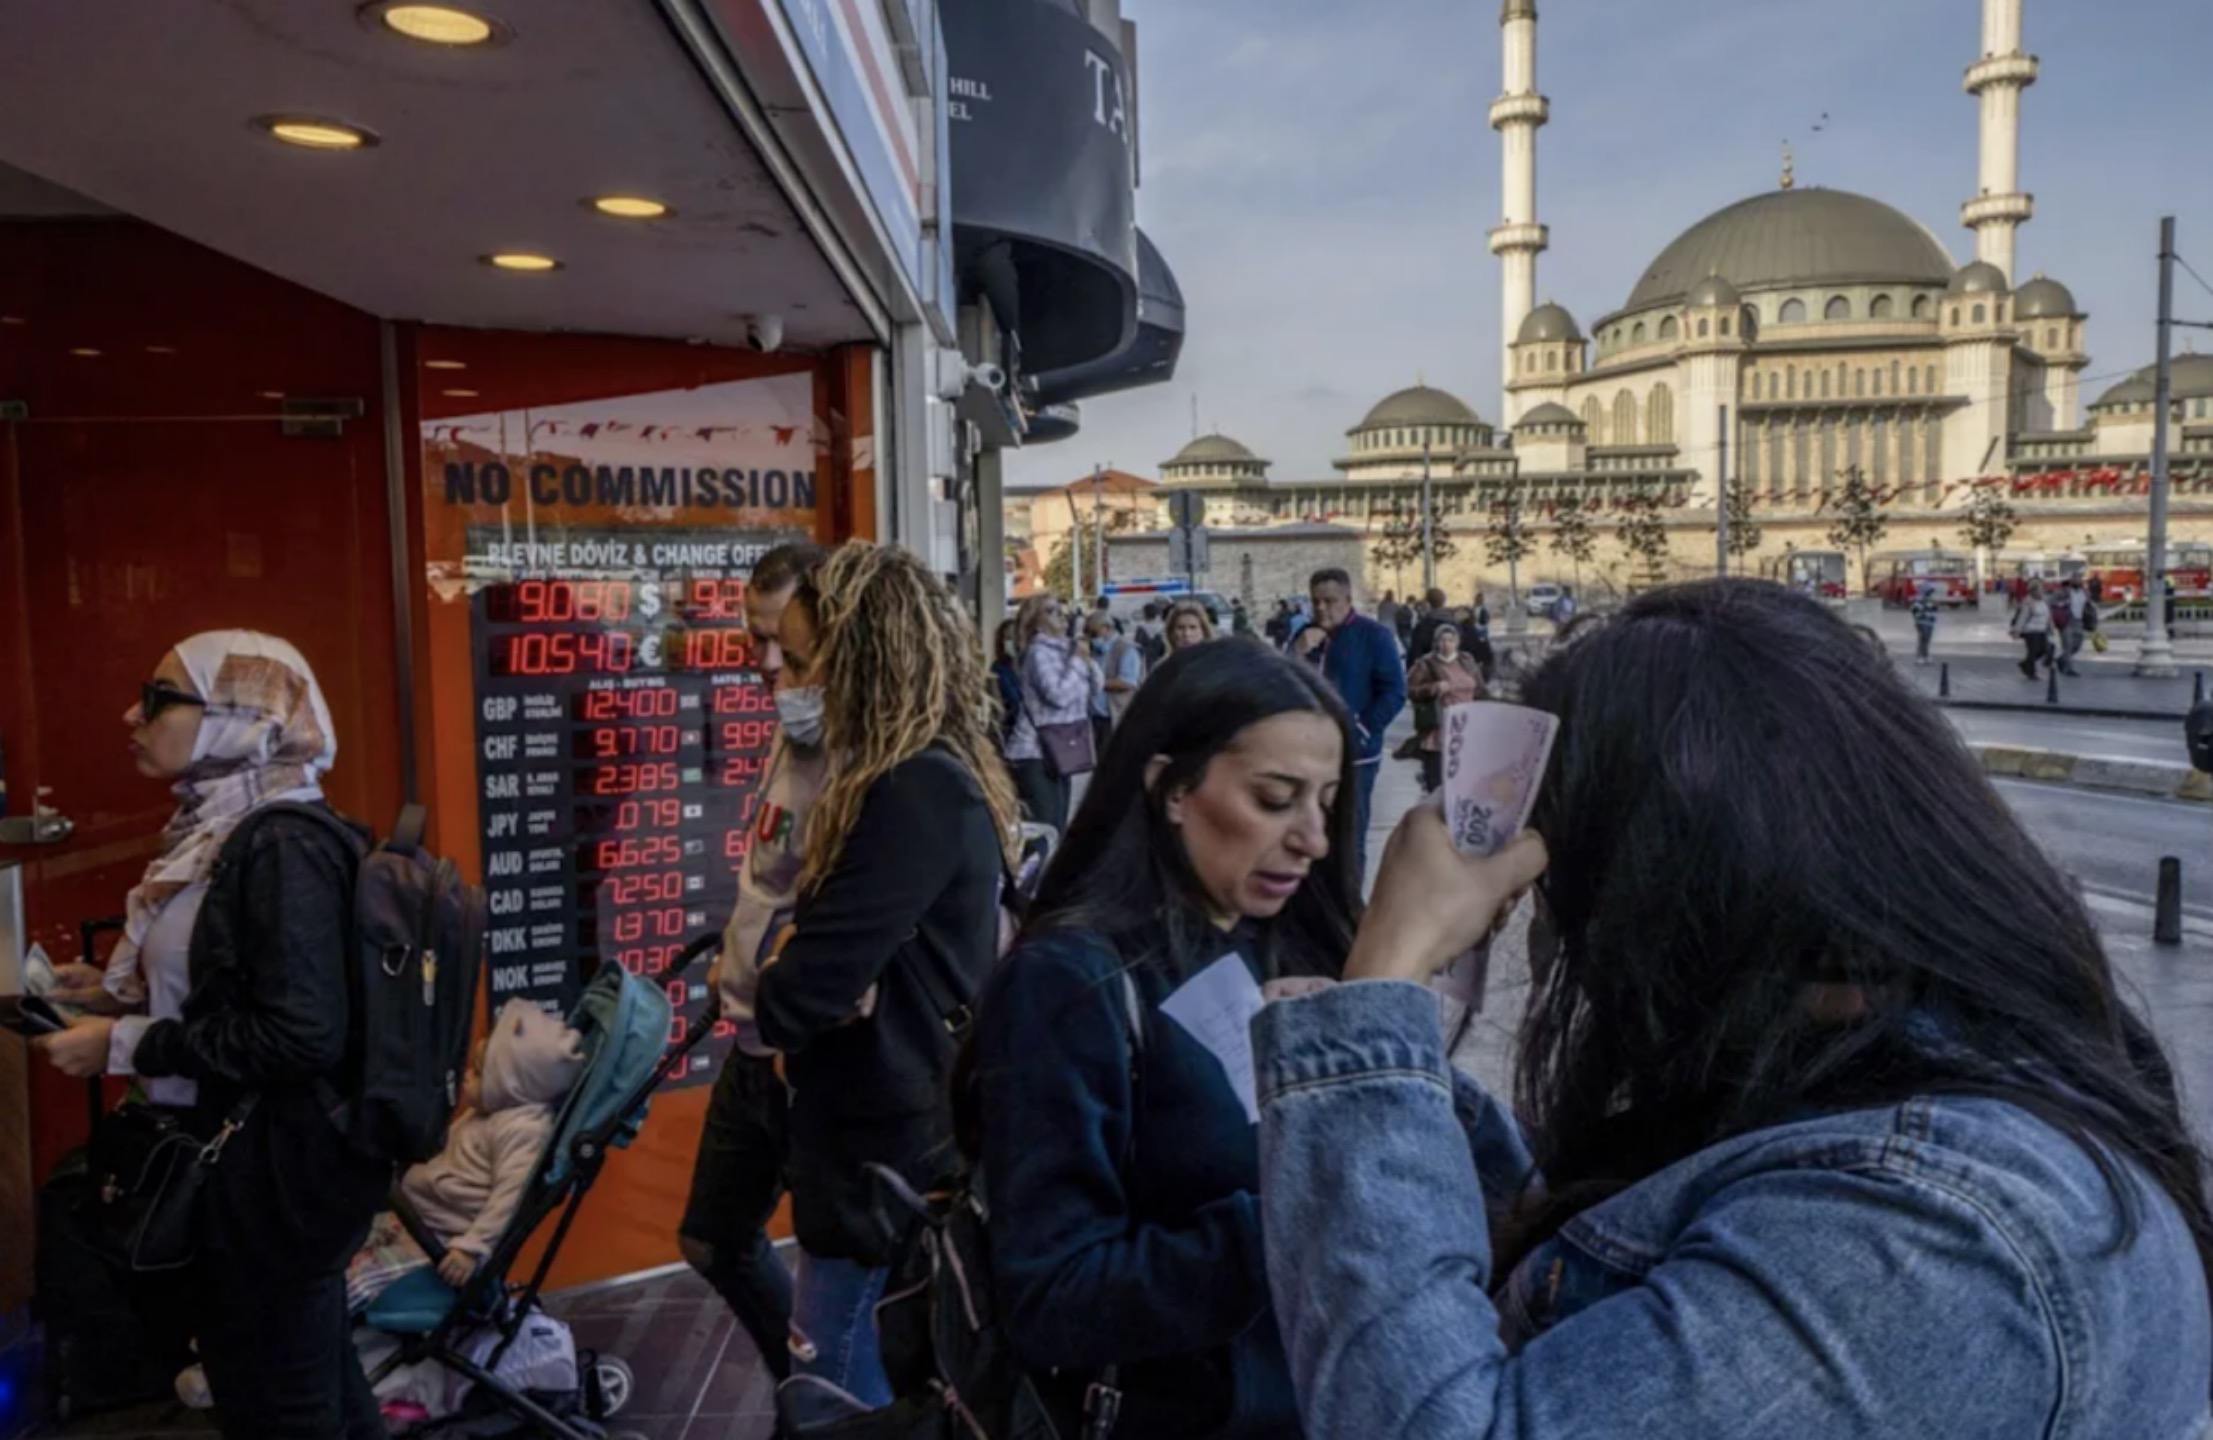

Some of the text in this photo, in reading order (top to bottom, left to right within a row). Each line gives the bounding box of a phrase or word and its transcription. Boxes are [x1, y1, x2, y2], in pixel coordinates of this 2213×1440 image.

[950, 77, 992, 100] HILL
[949, 102, 972, 121] EL
[446, 463, 816, 509] NO COMMISSION
[633, 543, 648, 564] &
[653, 543, 728, 565] CHANGE
[732, 544, 771, 566] OFF
[639, 583, 661, 619] $
[510, 633, 632, 673] 10.540
[639, 634, 661, 667] €
[483, 696, 517, 721] GBP
[484, 736, 517, 760] CHF
[486, 773, 520, 798] SAR
[487, 812, 518, 838] JPY
[1466, 804, 1492, 846] 200
[489, 851, 522, 876] AUD
[490, 889, 523, 915] CAD
[492, 927, 526, 953] DKK
[493, 965, 529, 992] NOK
